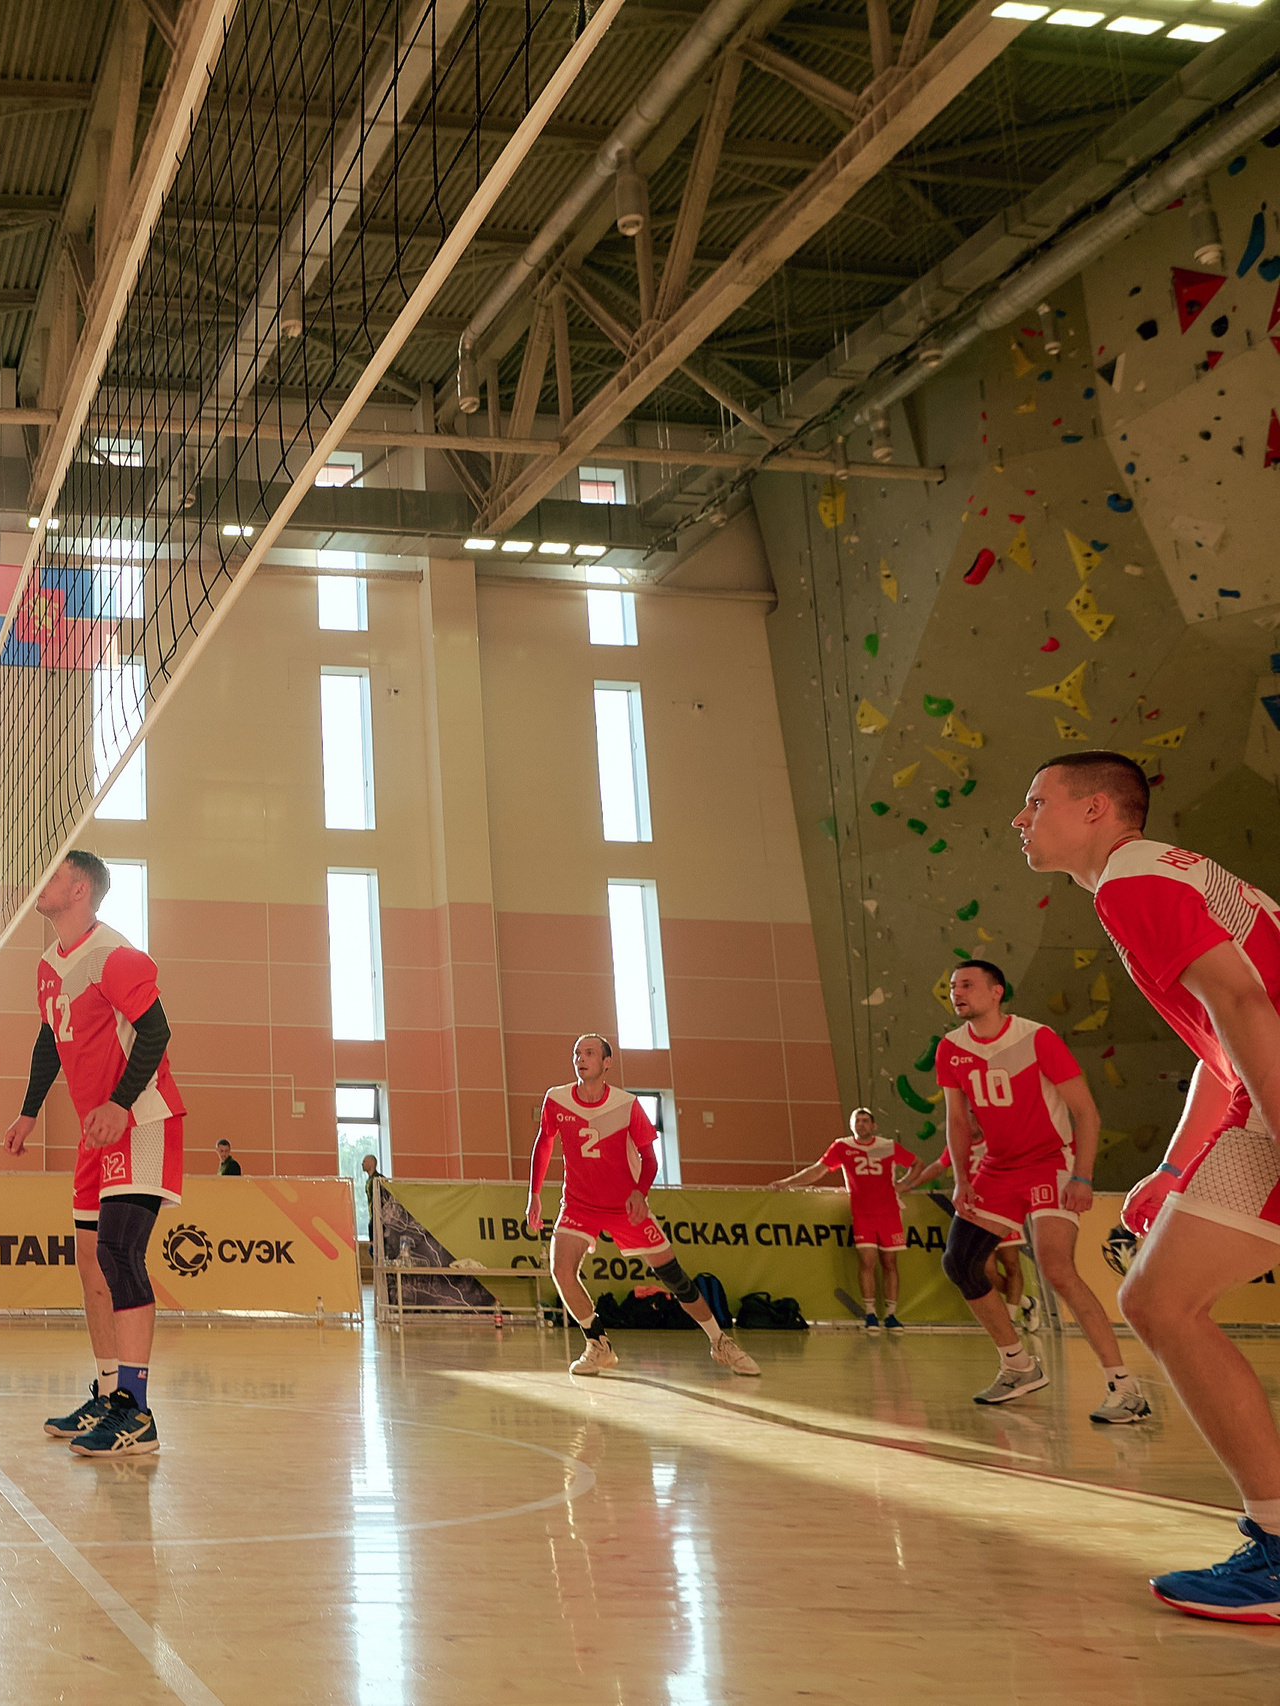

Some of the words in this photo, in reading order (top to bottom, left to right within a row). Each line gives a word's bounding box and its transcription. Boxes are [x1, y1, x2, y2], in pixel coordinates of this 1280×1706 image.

[46, 994, 73, 1042] 12
[968, 1068, 1014, 1107] 10
[578, 1127, 601, 1158] 2
[102, 1151, 126, 1183] 12
[853, 1156, 883, 1176] 25
[1031, 1184, 1054, 1207] 10
[644, 1225, 662, 1244] 2
[217, 1239, 296, 1265] СУЭК
